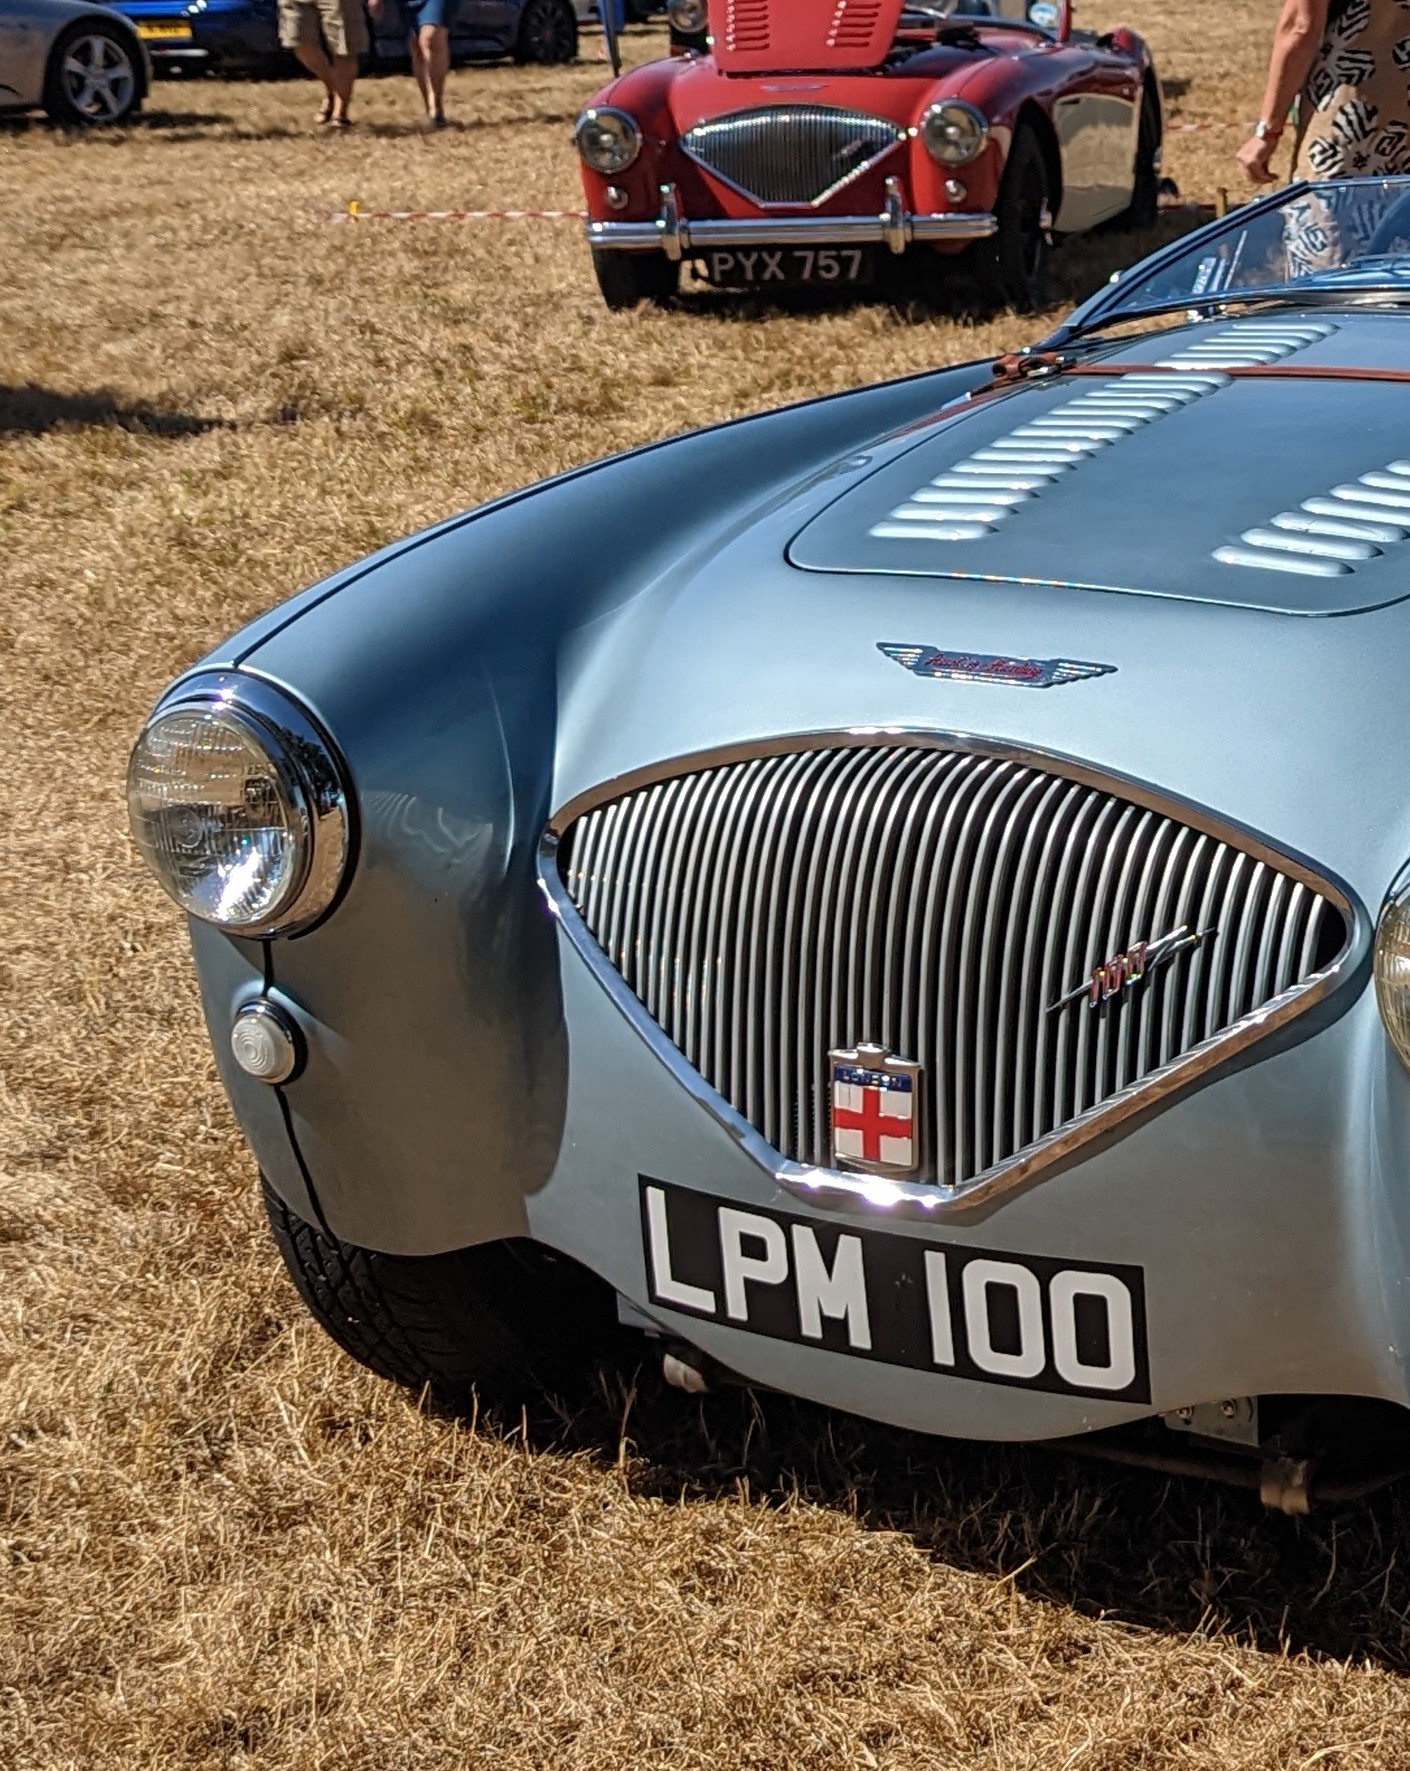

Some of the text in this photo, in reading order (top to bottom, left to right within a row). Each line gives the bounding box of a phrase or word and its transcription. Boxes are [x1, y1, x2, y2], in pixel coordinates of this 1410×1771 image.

[712, 249, 862, 282] PYX 757
[646, 1186, 1136, 1391] LPM 100
